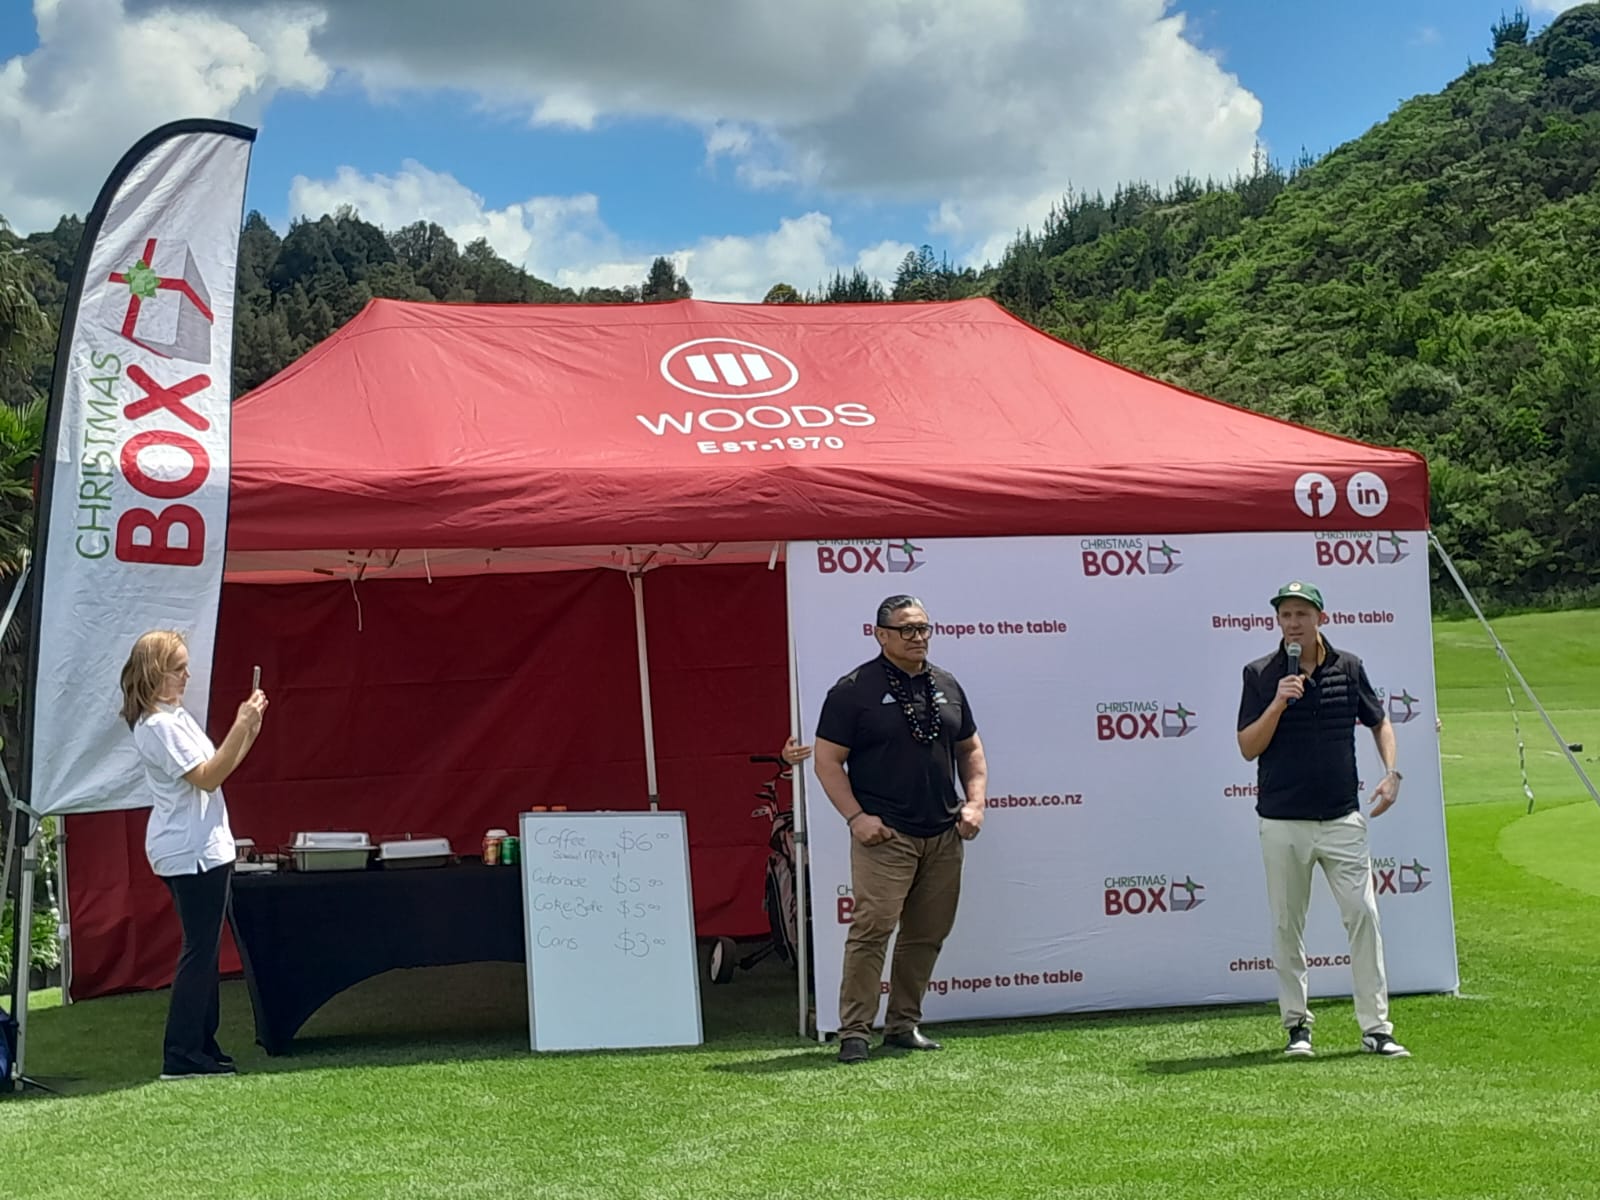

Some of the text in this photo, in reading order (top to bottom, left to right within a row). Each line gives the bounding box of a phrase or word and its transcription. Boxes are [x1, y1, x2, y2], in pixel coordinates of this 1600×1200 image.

[636, 402, 876, 436] WOODS
[75, 351, 122, 559] CHRISTMAS
[114, 364, 212, 567] BOX
[1080, 538, 1143, 550] CHRISTMAS
[1315, 539, 1375, 566] BOX
[817, 546, 885, 573] BOX
[1082, 550, 1146, 577] BOX
[935, 620, 1067, 639] hope to the table
[1212, 614, 1274, 631] Bringing
[1333, 612, 1355, 624] the
[1359, 610, 1394, 623] table
[1096, 701, 1158, 713] CHRISTMAS
[1097, 713, 1159, 741] BOX
[534, 826, 586, 849] Coffee
[1104, 875, 1167, 888] CHRISTMAS
[1104, 887, 1167, 916] BOX
[537, 925, 578, 950] Cans
[951, 976, 992, 993] hope
[995, 974, 1011, 987] to
[1014, 973, 1040, 986] the
[1043, 969, 1083, 984] table
